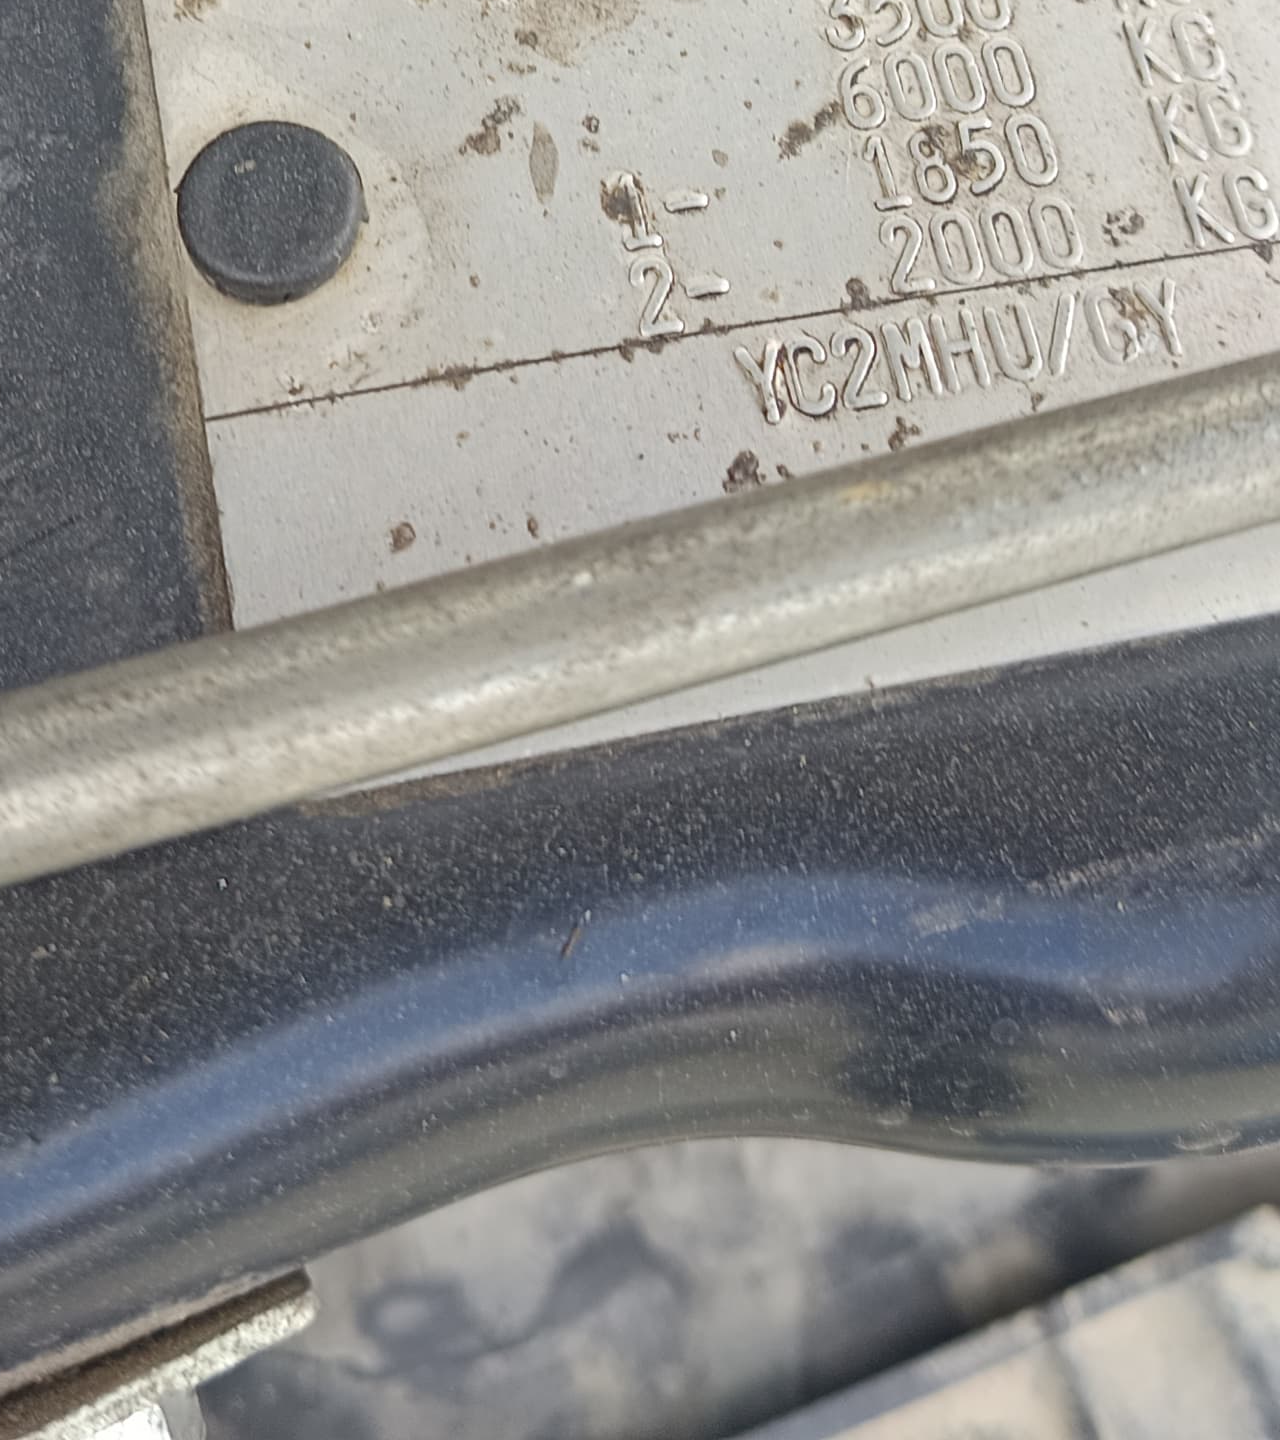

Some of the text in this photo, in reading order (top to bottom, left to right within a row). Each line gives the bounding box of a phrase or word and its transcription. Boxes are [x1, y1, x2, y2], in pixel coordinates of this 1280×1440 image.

[841, 10, 1225, 131] 6000 KG
[862, 111, 1060, 212] 1850
[1149, 86, 1253, 165] KG
[627, 162, 1280, 338] 2- 2000 KG
